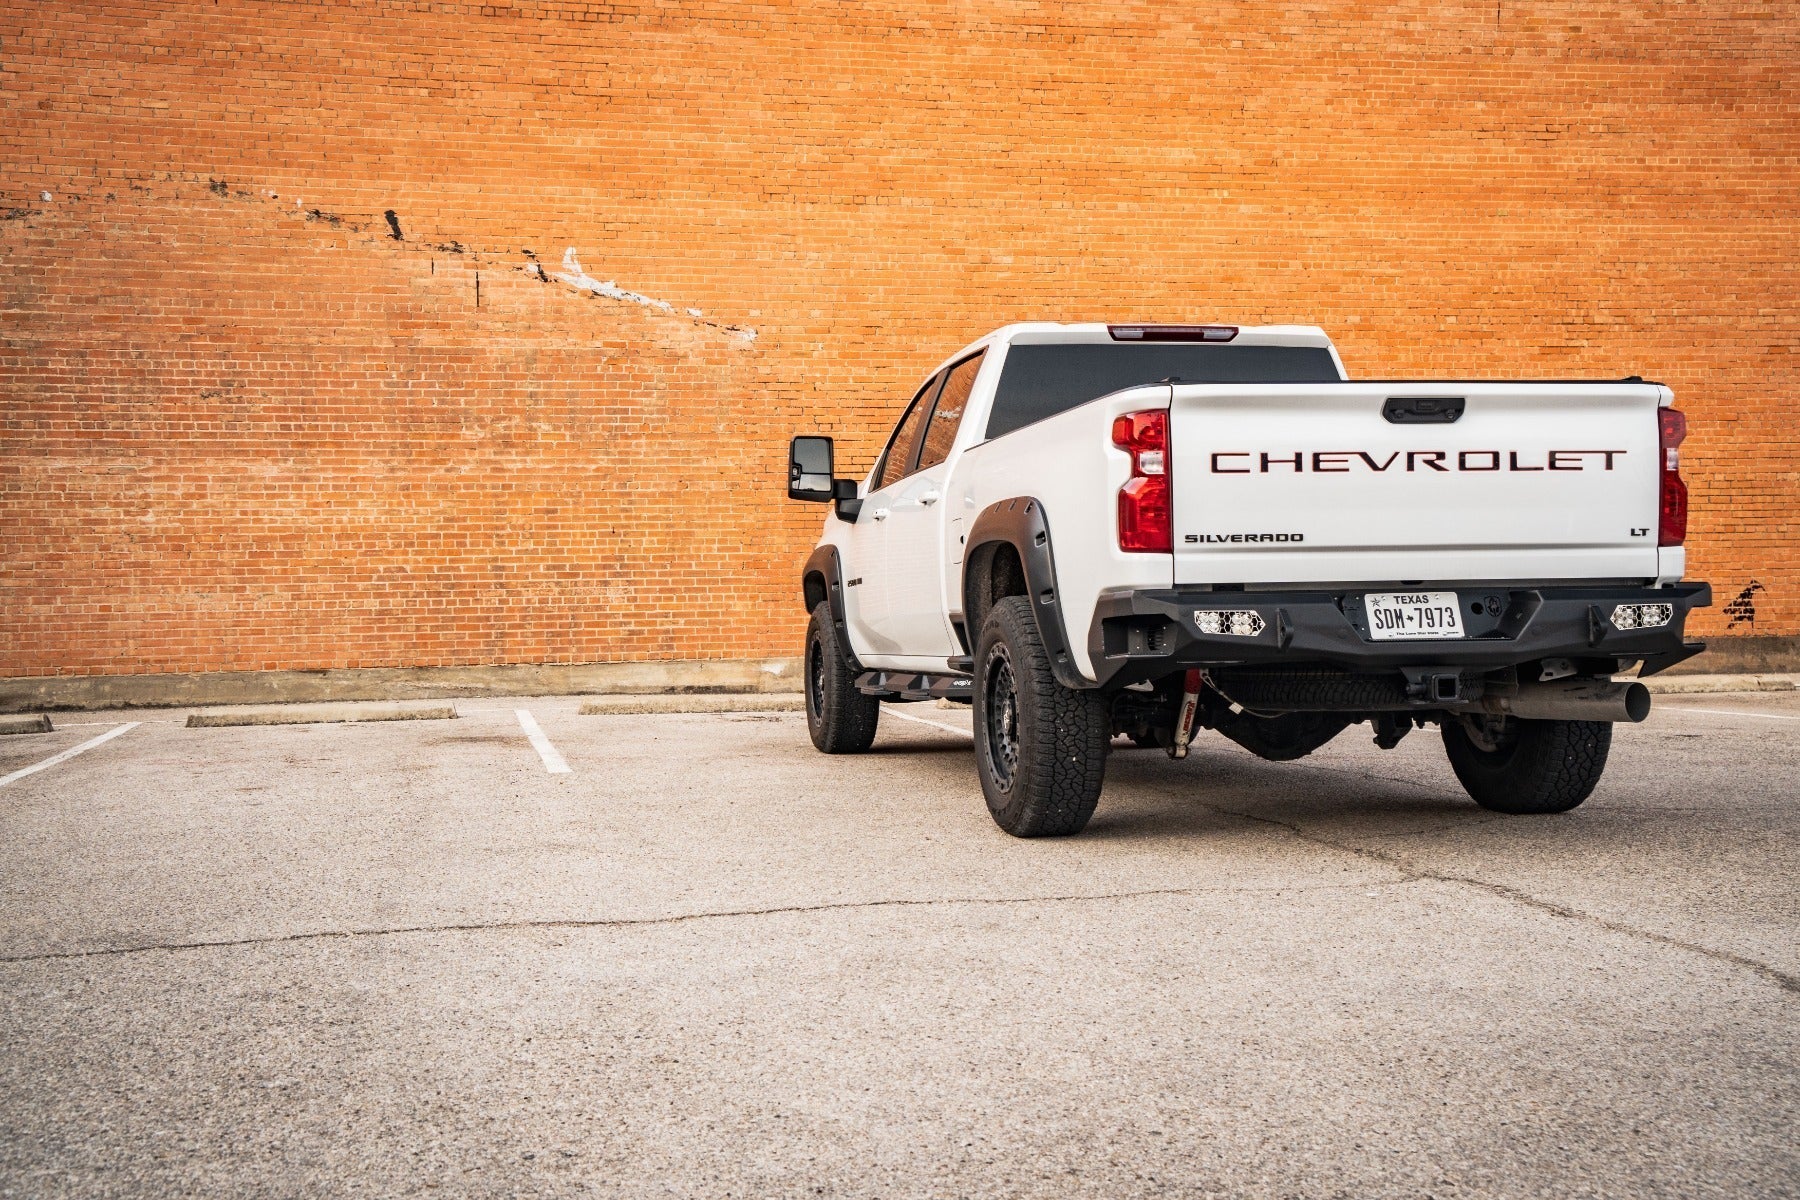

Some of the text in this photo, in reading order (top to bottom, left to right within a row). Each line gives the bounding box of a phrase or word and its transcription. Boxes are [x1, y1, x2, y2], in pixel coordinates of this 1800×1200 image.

[1210, 451, 1628, 473] CHEVROLET
[1630, 527, 1650, 536] LT
[1184, 533, 1304, 543] SILVERADO
[1393, 595, 1430, 605] TEXAS
